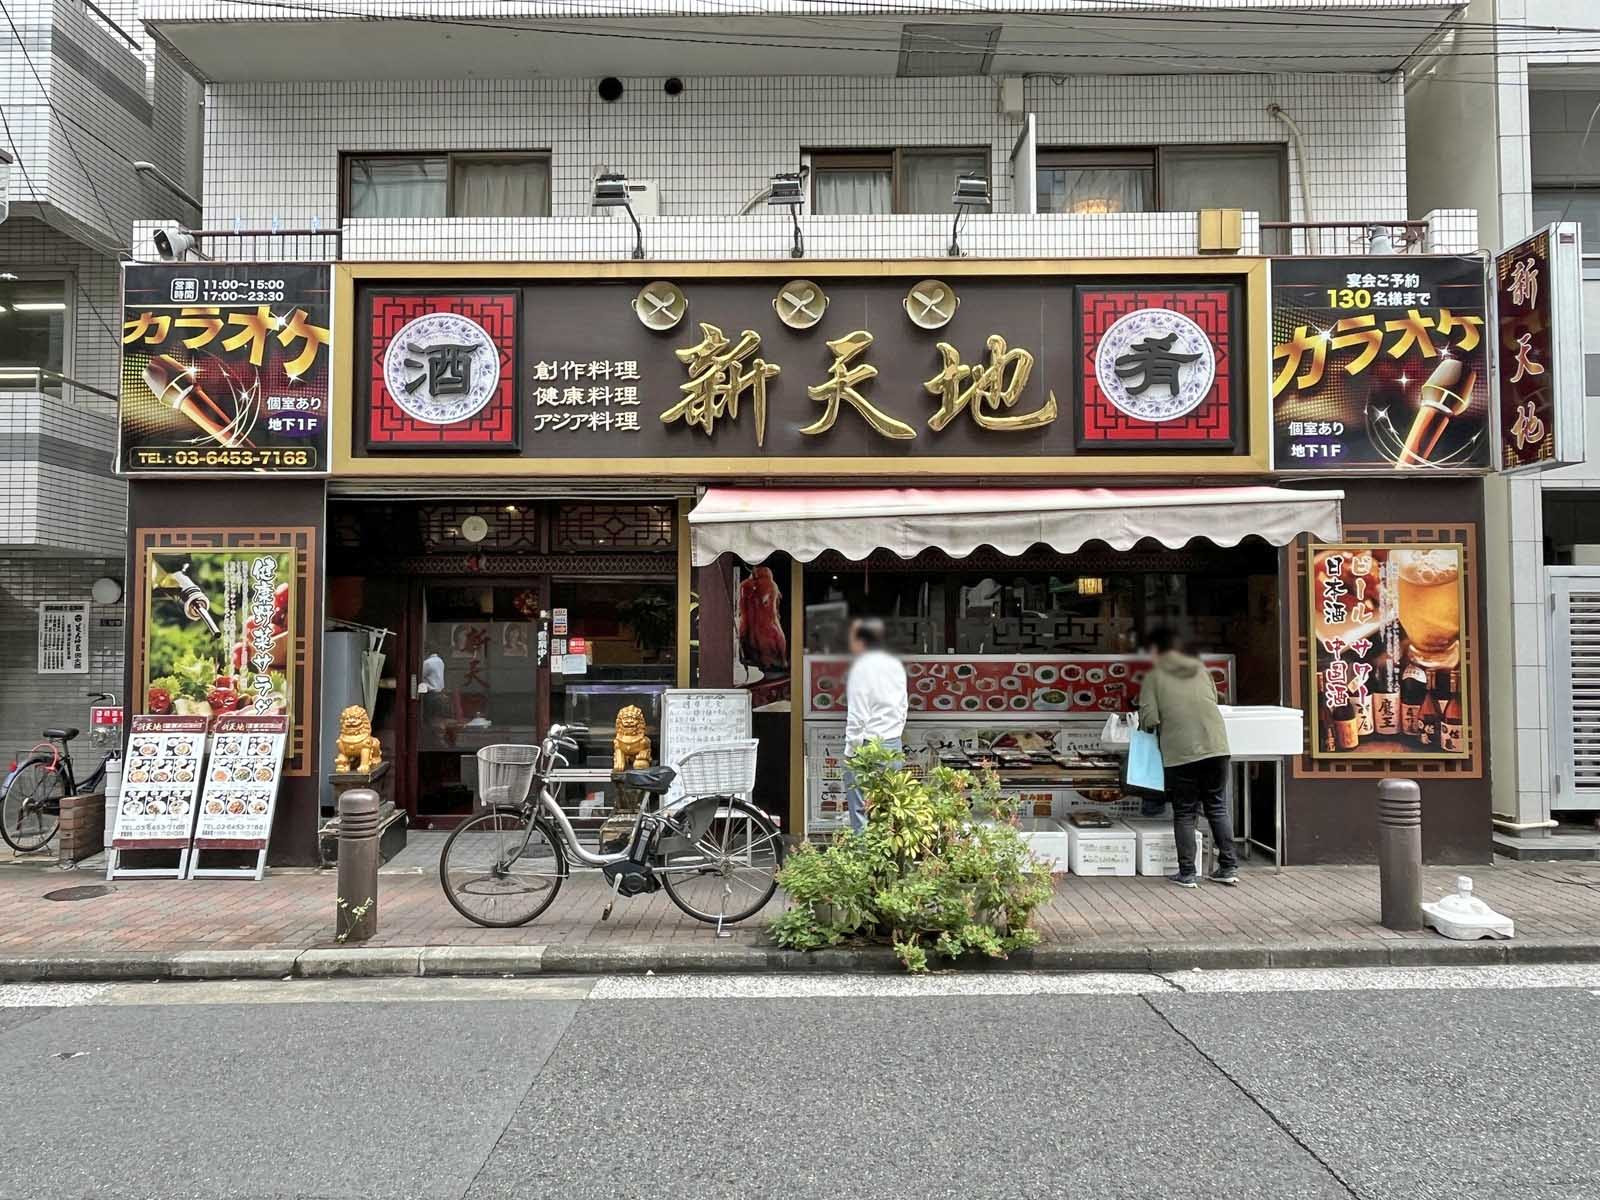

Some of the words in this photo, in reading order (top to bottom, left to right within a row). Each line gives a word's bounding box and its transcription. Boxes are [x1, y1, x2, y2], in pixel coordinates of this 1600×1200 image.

[174, 290, 195, 300] 時間
[1346, 273, 1420, 288] 宴会ご予約
[124, 304, 330, 378] カラオケ
[1271, 308, 1485, 398] カラオケ
[1507, 257, 1545, 450] 新天地
[403, 342, 479, 397] 酒
[533, 360, 641, 382] 創作料理
[659, 323, 1058, 447] 新天地
[1114, 332, 1204, 397] 肴
[266, 397, 322, 411] 個室あり
[533, 385, 641, 407] 健康料理
[267, 417, 318, 432] 地下1F
[533, 411, 641, 432] アジア料理
[1288, 421, 1345, 437] 個室あり
[1290, 443, 1342, 459] 地下1F
[1323, 555, 1348, 625] 日本酒
[1351, 555, 1373, 624] ビール
[1323, 637, 1349, 707] 中国酒
[1351, 638, 1373, 706] サワー
[1379, 698, 1396, 729] 魔王
